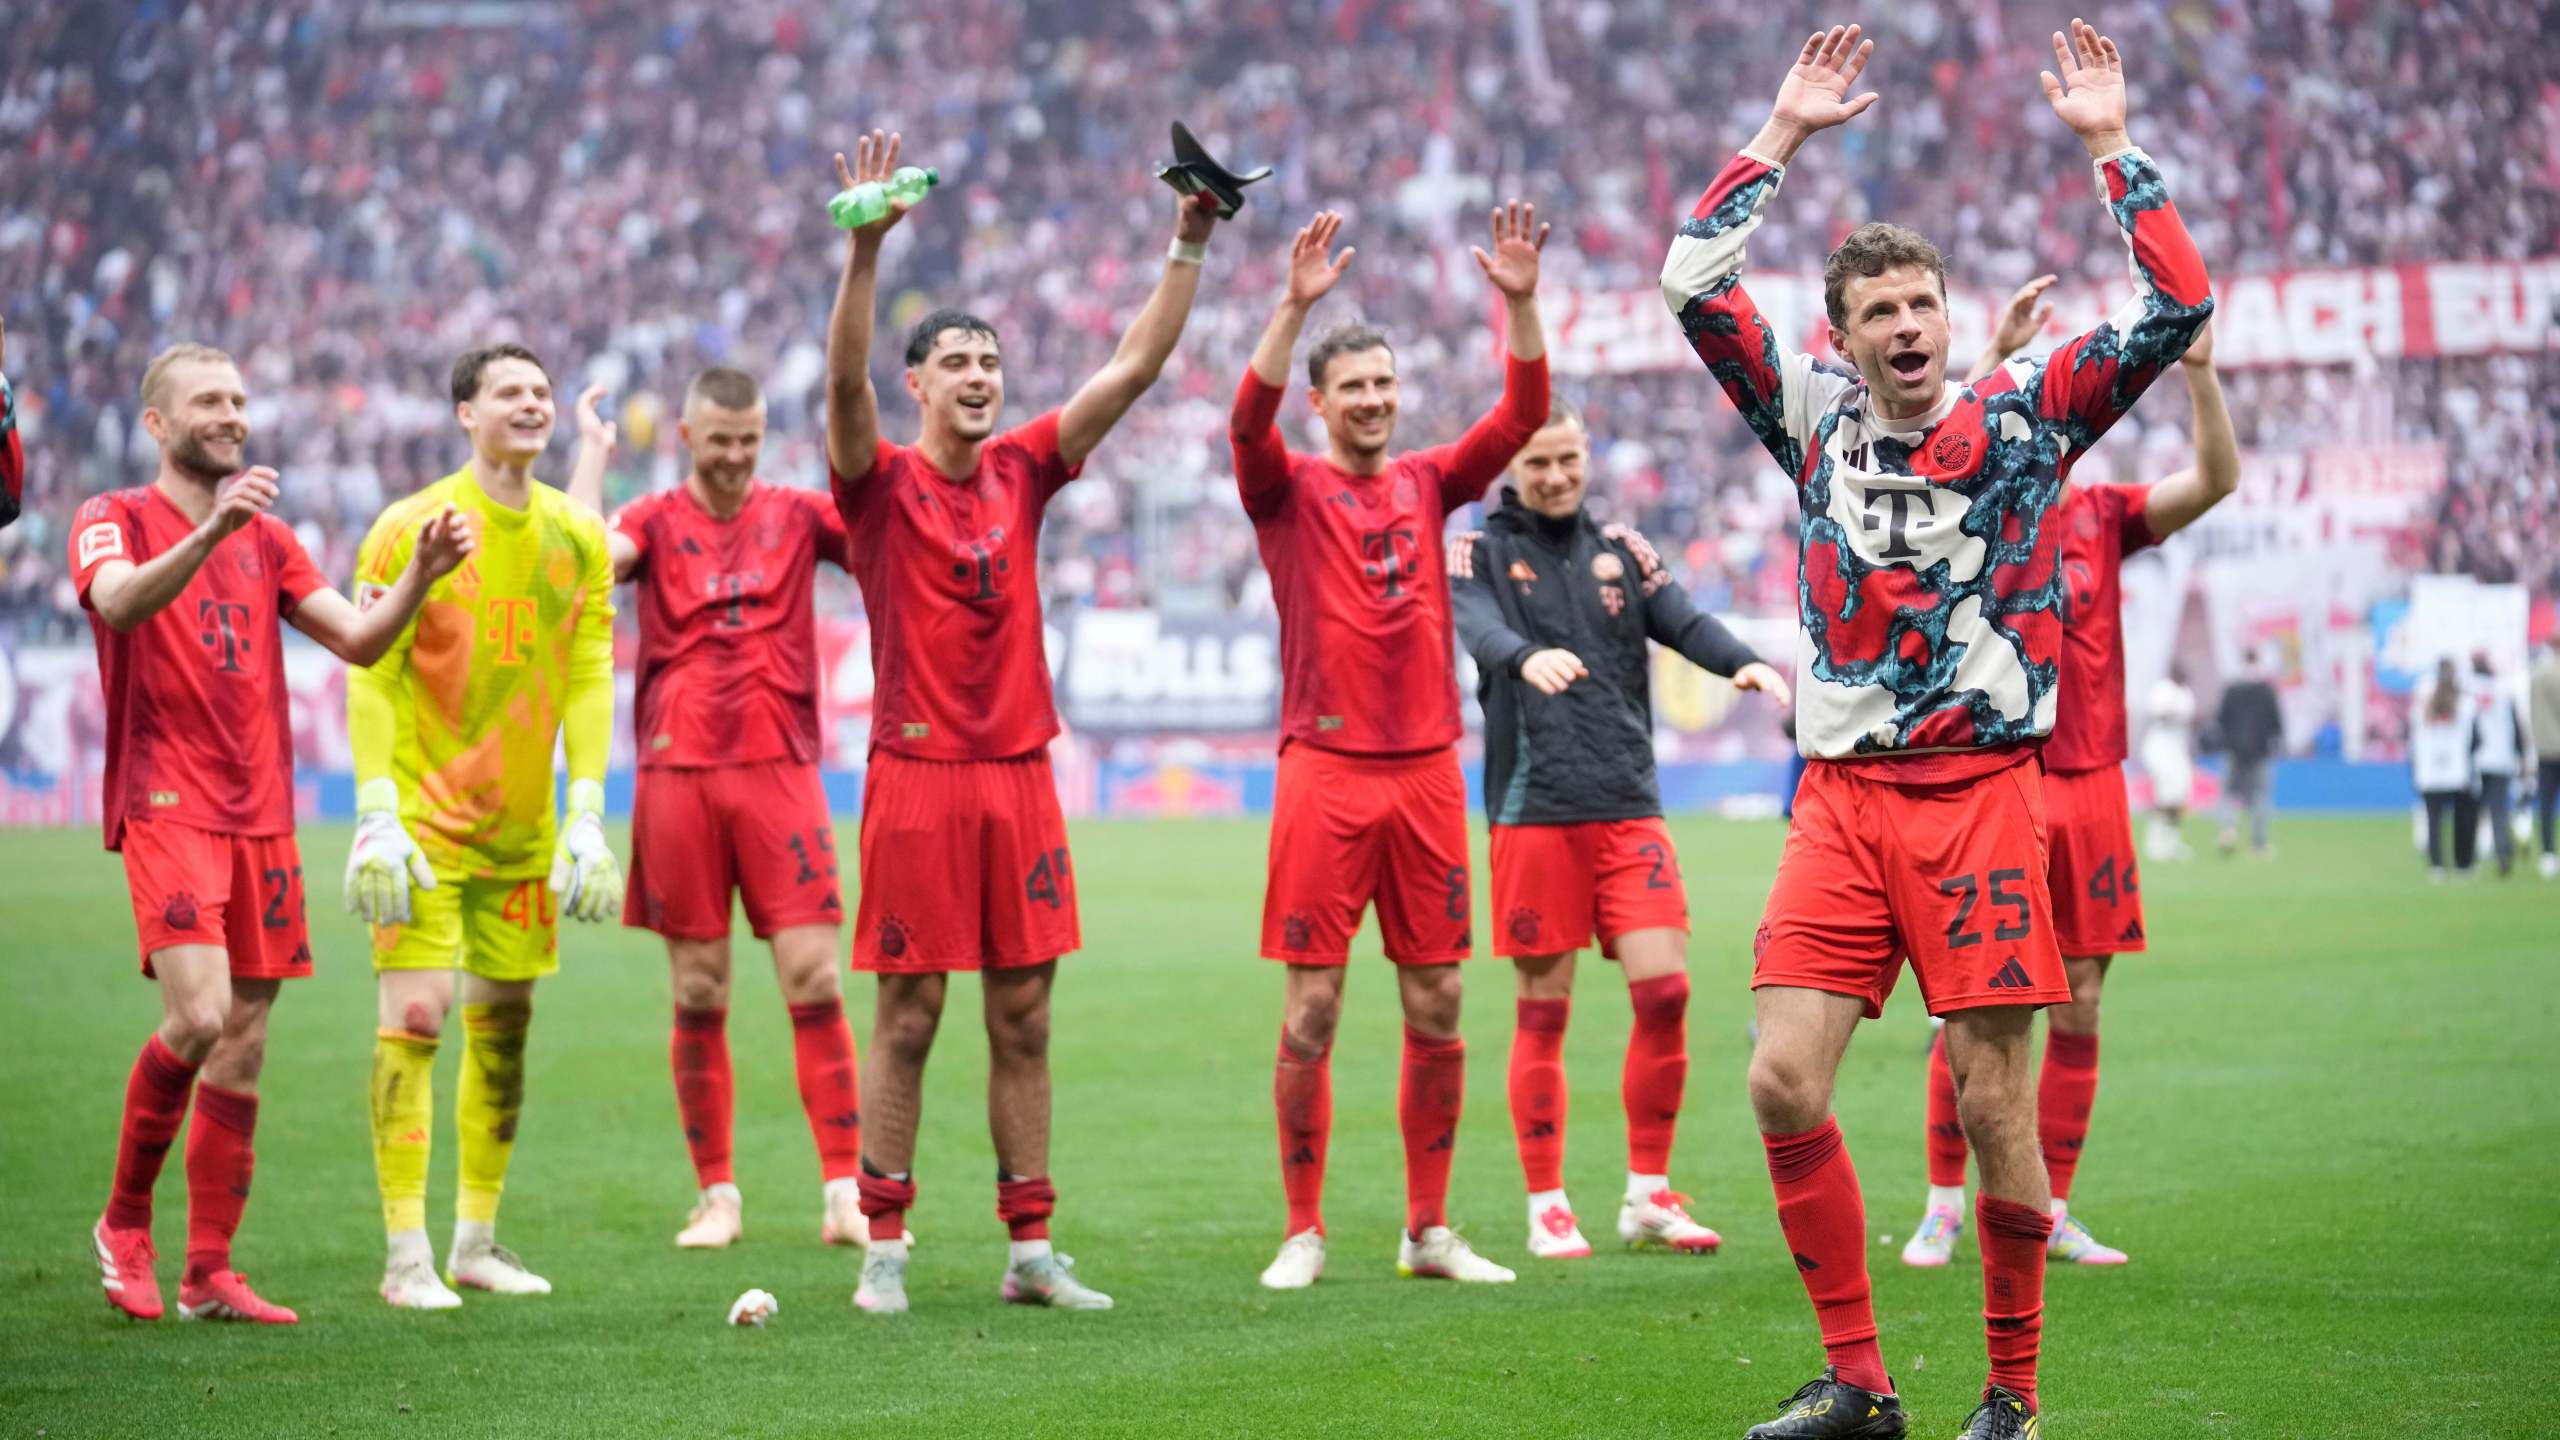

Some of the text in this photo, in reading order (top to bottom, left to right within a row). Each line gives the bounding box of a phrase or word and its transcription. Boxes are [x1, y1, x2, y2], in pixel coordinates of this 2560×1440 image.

[2211, 264, 2403, 366] ACH
[2430, 258, 2560, 354] EU
[1862, 488, 1936, 559] T
[952, 527, 1008, 601] T
[1362, 529, 1417, 598] T
[199, 599, 251, 673] T
[488, 597, 537, 664] T
[1446, 867, 1469, 921] 8
[1638, 842, 1682, 889] 2
[1940, 867, 2031, 949] 25
